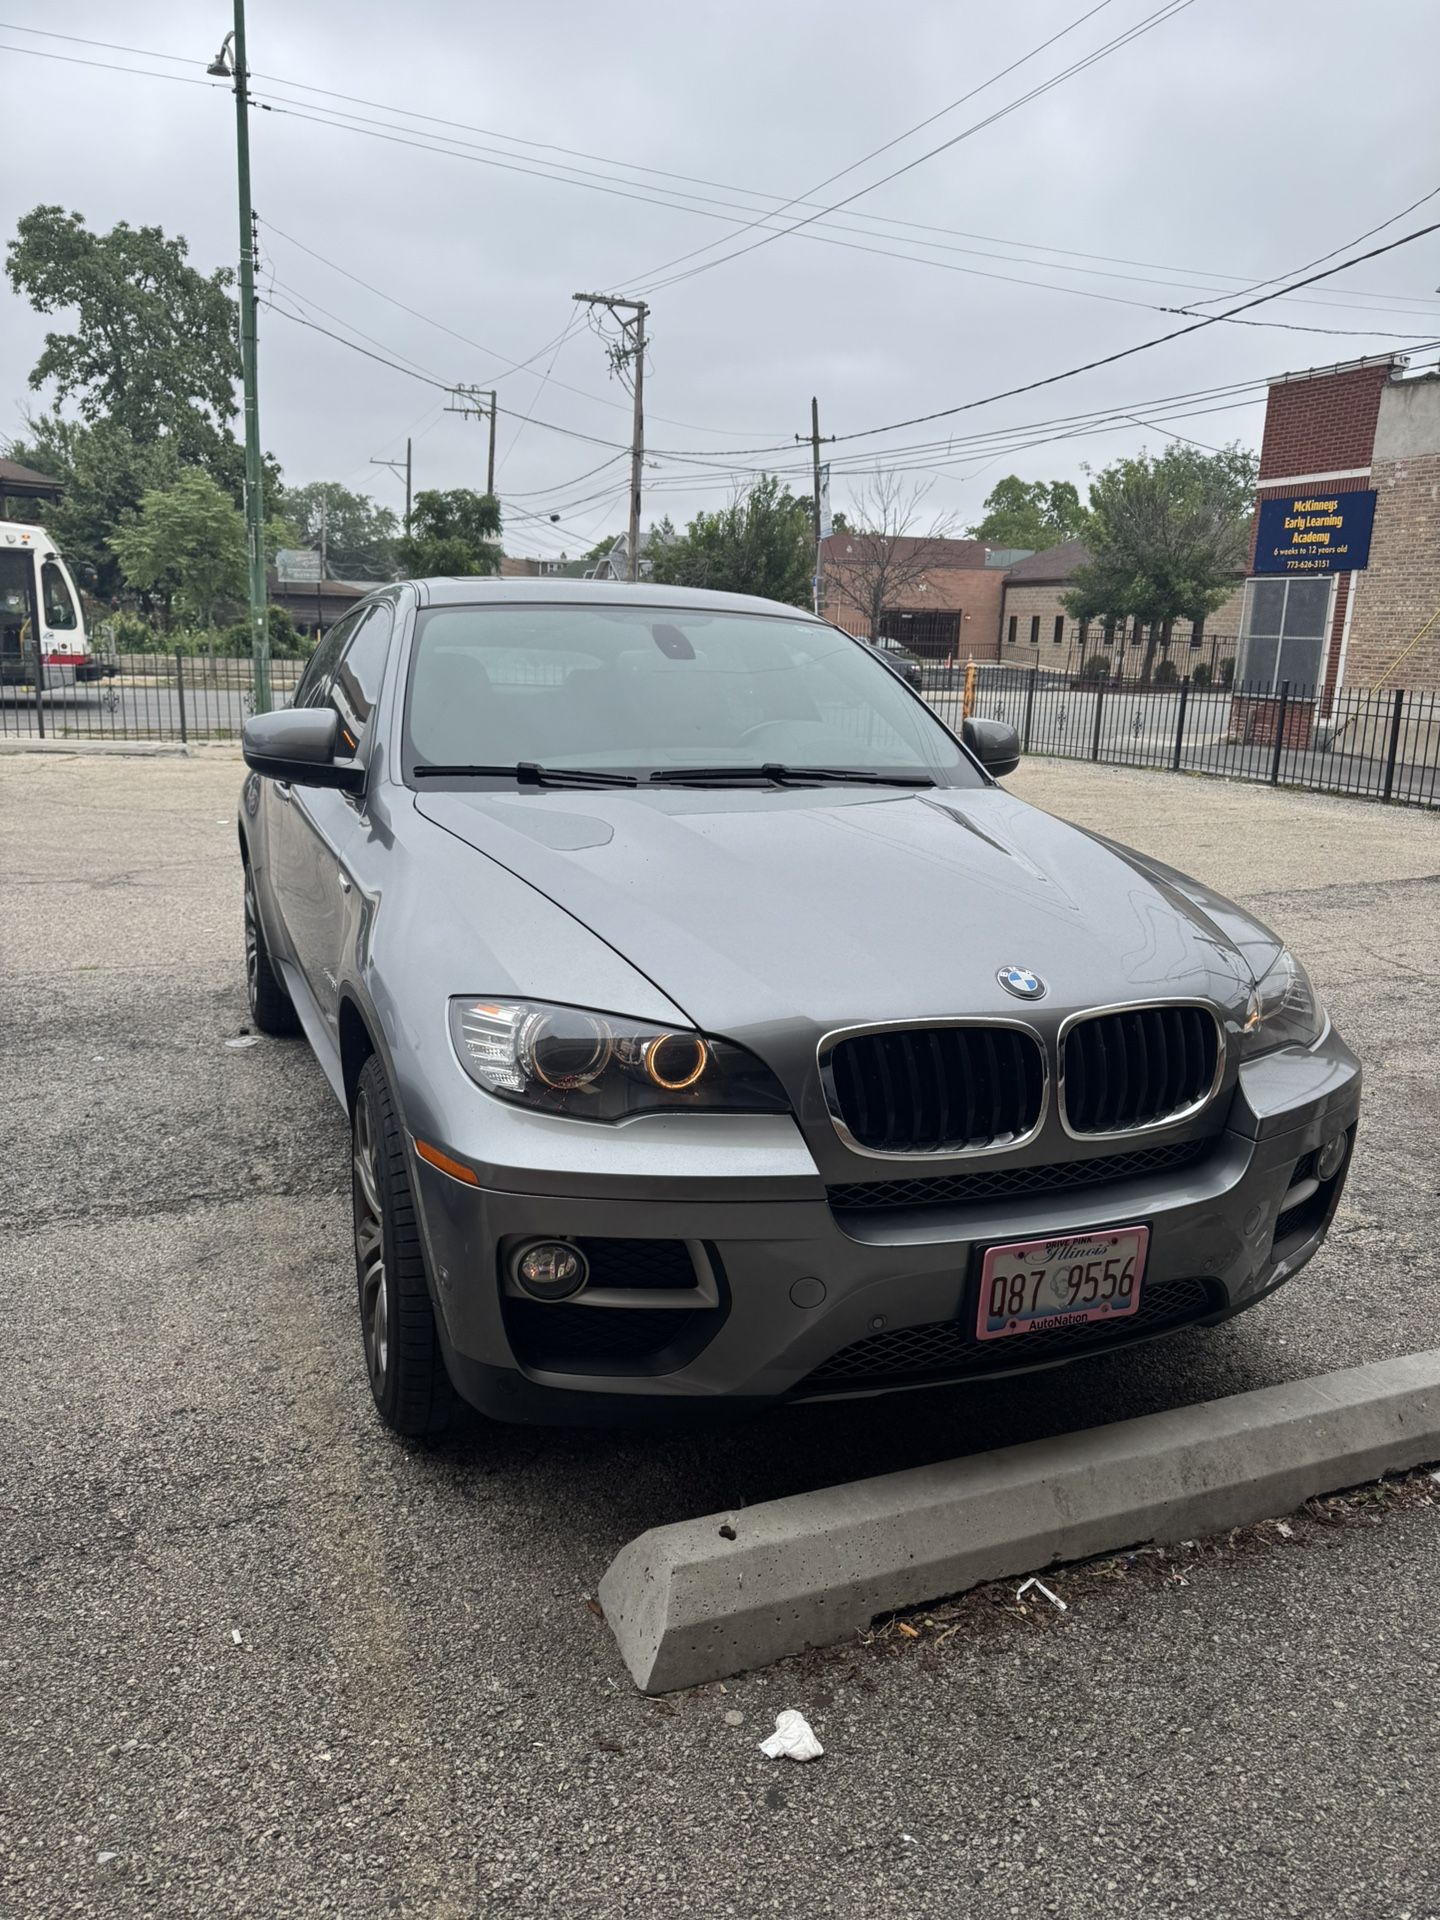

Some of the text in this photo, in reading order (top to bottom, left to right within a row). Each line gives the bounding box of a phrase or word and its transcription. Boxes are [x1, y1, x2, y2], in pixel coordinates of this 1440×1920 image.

[1293, 500, 1338, 512] McKinneys
[1284, 514, 1343, 530] Early Learning
[1292, 532, 1330, 545] Academy
[1273, 545, 1348, 556] 6 weeks to 12 years old
[1286, 560, 1329, 569] 773-626-3151
[1045, 1236, 1093, 1249] DRIVE PINK
[1025, 1243, 1111, 1265] Illinois
[989, 1257, 1134, 1317] Q87 9556
[1028, 1312, 1088, 1331] AutoNation
